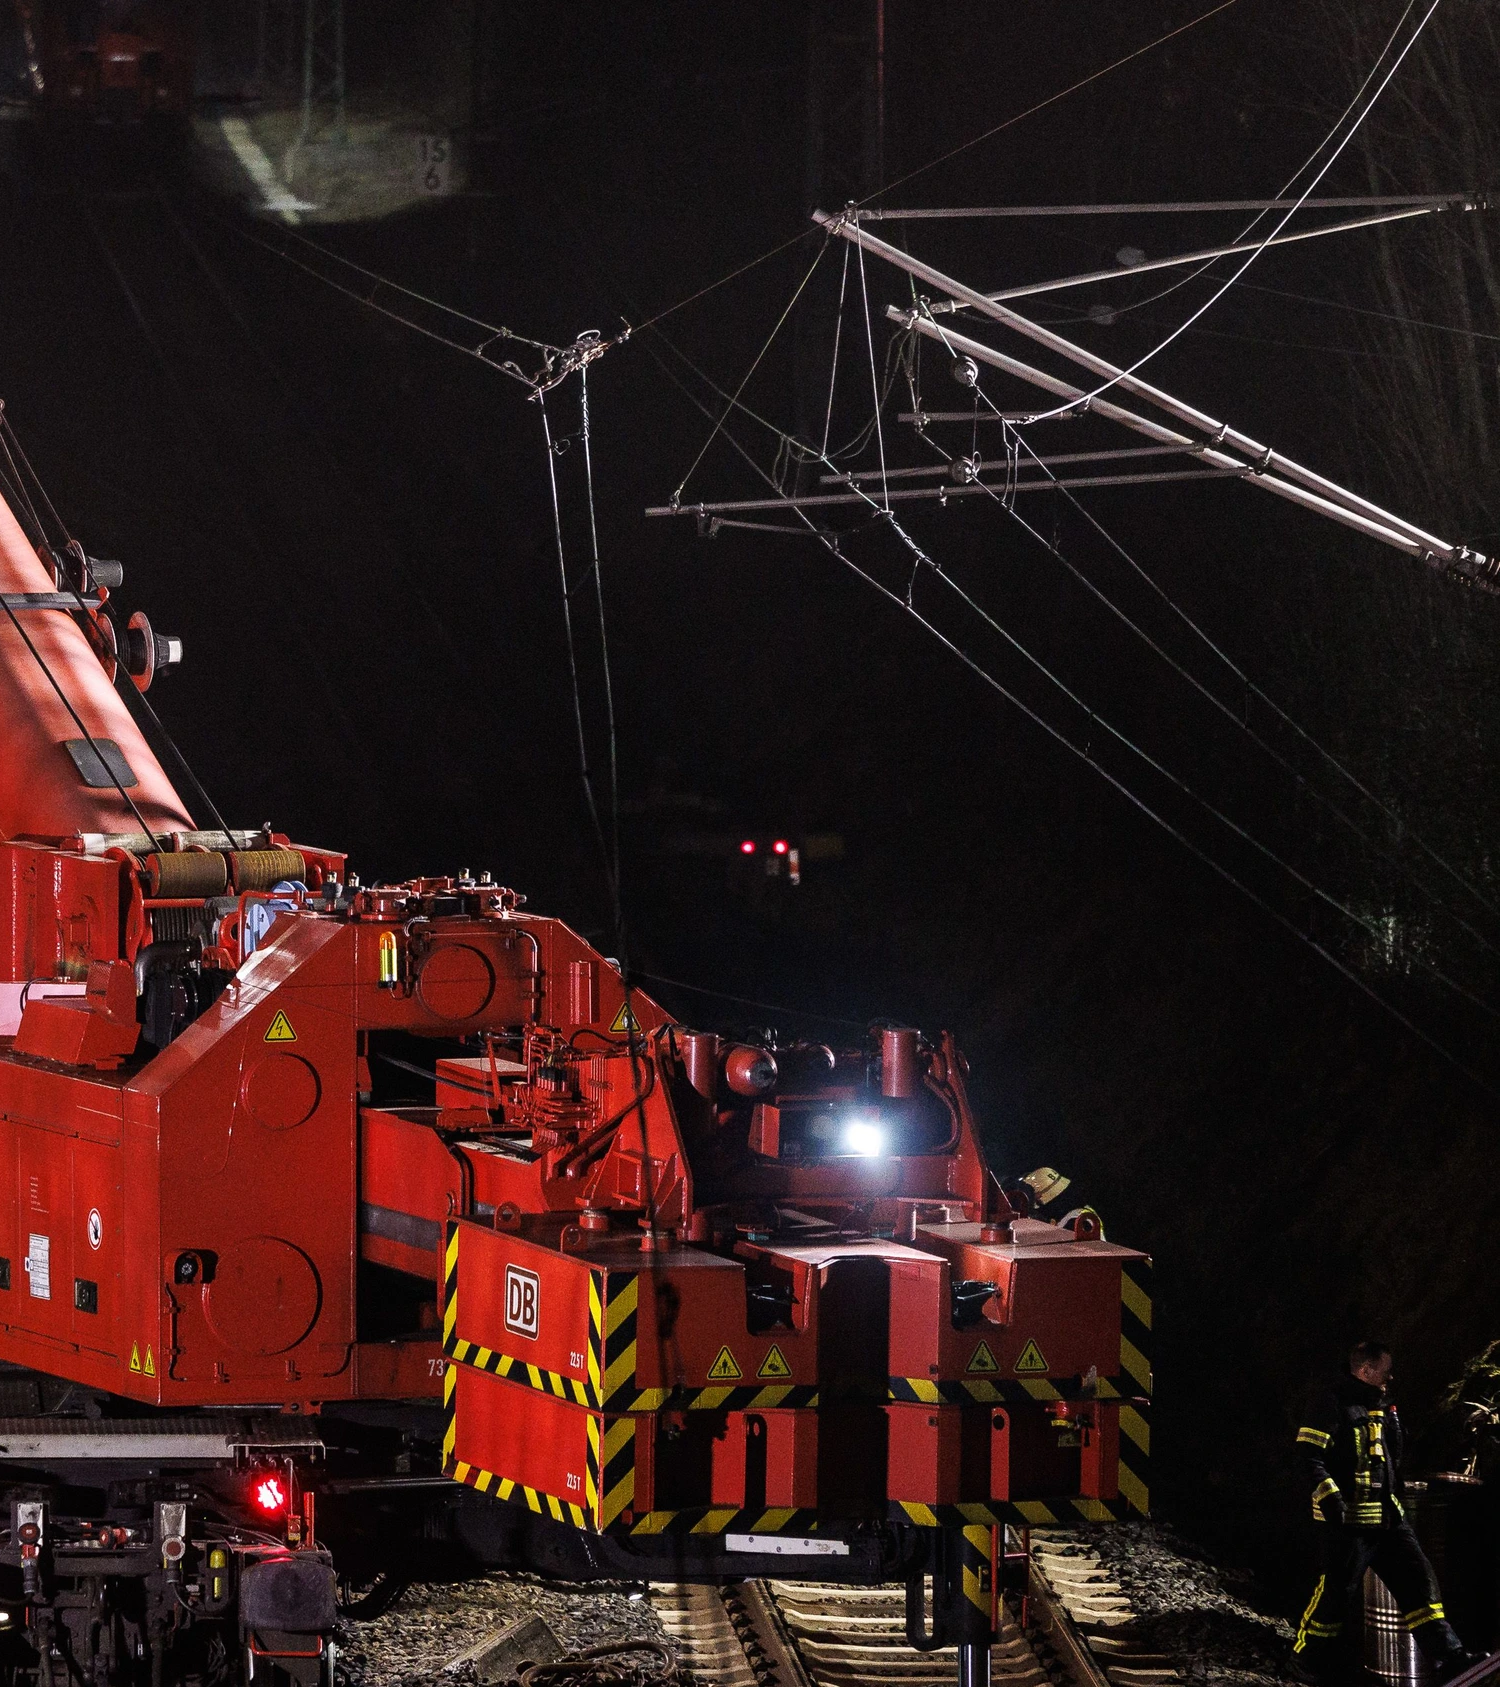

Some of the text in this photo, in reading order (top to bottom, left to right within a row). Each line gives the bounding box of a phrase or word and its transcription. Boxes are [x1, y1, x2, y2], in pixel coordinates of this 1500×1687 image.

[425, 165, 441, 191] 6
[508, 1275, 536, 1328] DB
[428, 1358, 447, 1377] 73
